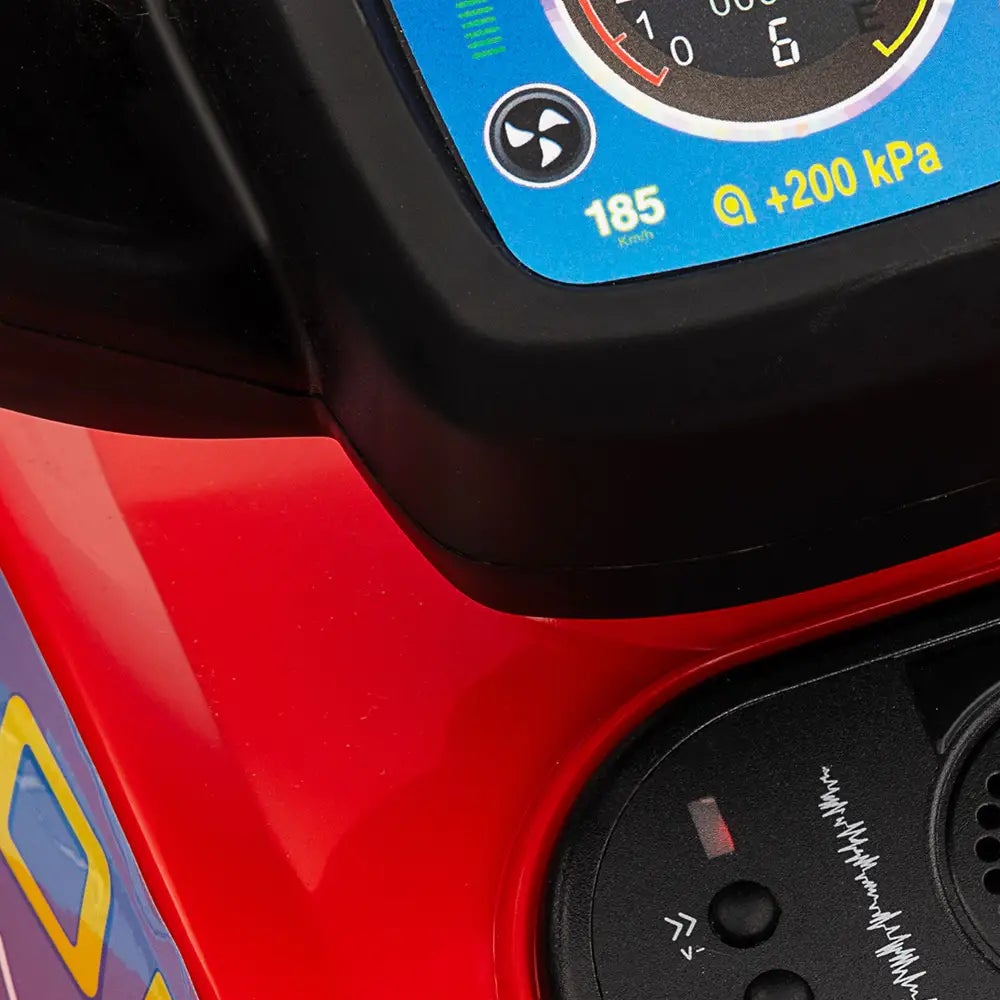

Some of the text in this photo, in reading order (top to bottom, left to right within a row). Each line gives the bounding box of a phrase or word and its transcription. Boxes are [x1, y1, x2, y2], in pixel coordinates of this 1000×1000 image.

[635, 10, 655, 40] 1
[669, 35, 695, 67] 0
[766, 140, 943, 215] +200 kPa
[584, 184, 666, 237] 185
